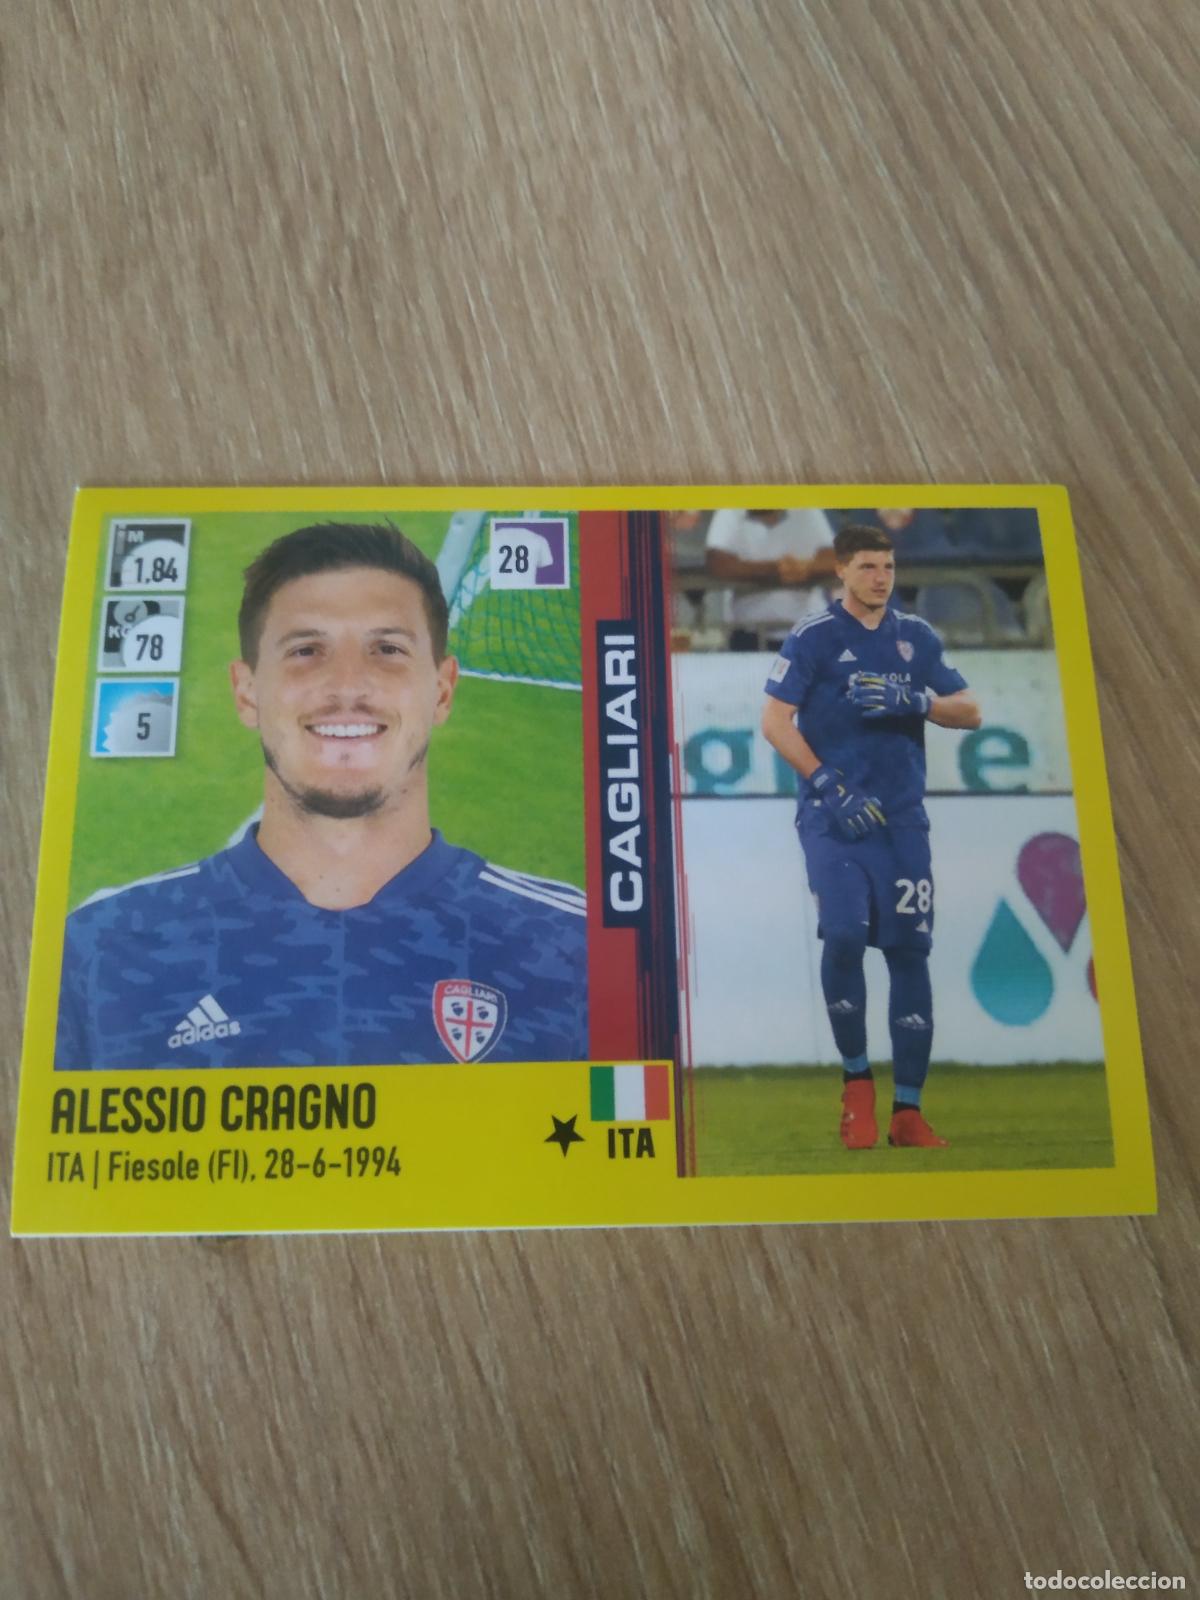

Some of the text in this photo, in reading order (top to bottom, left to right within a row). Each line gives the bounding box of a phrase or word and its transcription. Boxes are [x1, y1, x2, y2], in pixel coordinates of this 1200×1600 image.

[498, 544, 530, 574] 28
[136, 634, 164, 661] 78
[136, 713, 151, 741] 5
[603, 634, 644, 912] CAGLIARI
[895, 879, 933, 914] 28
[167, 1020, 242, 1049] adidas
[51, 1082, 377, 1134] ALESSIO CRAGNO
[607, 1127, 656, 1159] ITA
[48, 1152, 85, 1183] ITA
[107, 1150, 200, 1182] Fiesole
[264, 1146, 402, 1180] 28-6-1994
